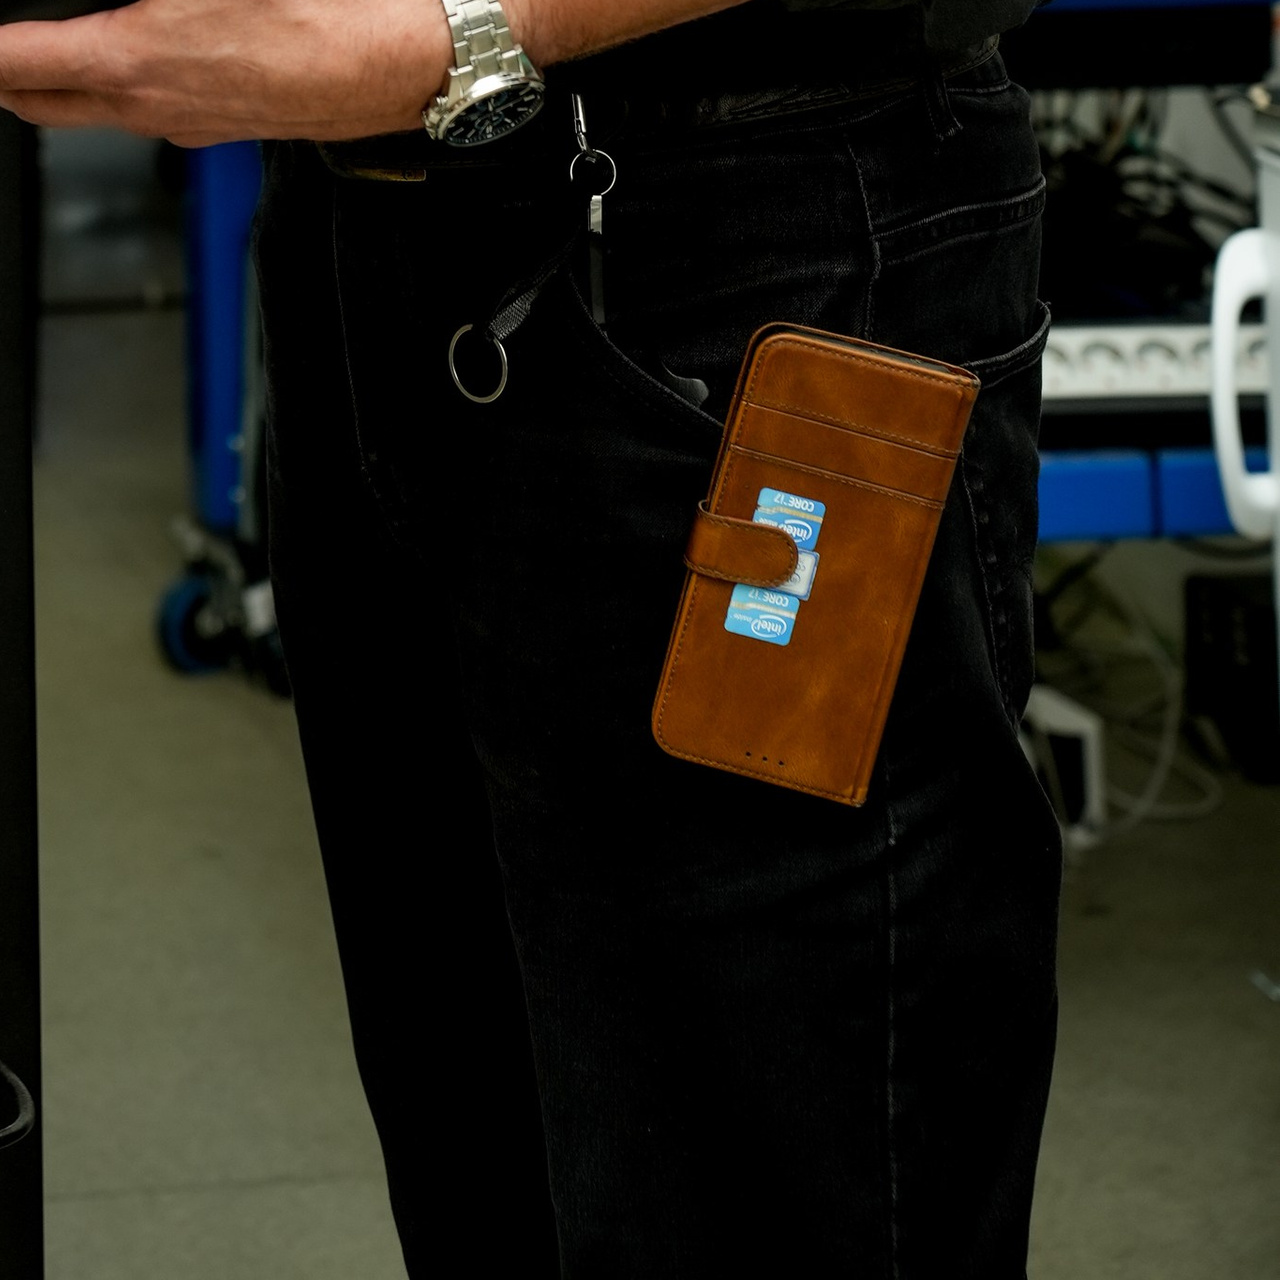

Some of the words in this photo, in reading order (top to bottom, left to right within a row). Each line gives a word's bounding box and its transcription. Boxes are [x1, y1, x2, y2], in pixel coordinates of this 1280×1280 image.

[788, 493, 815, 513] CORE
[762, 590, 789, 607] CORE
[756, 618, 783, 636] intel
